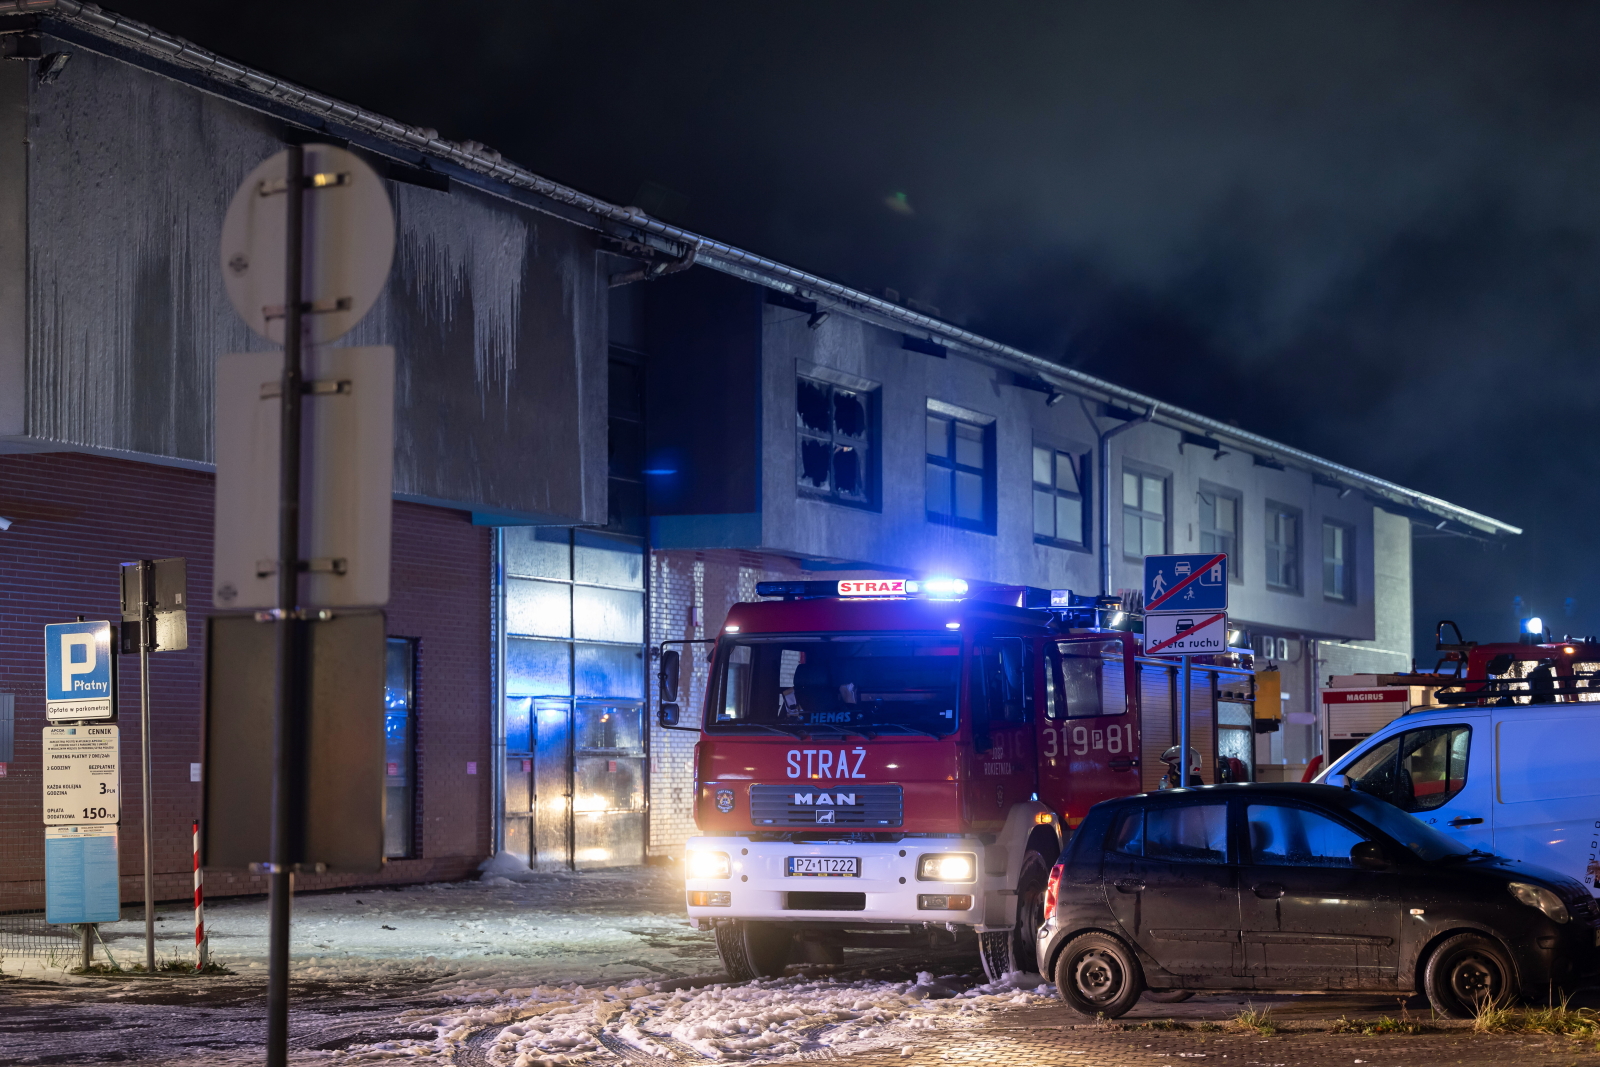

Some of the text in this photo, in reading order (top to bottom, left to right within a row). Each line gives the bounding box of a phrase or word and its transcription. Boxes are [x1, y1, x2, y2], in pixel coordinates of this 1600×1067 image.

[1189, 637, 1219, 648] ruchu
[61, 632, 97, 692] P
[74, 679, 108, 693] Płatny
[1346, 693, 1384, 702] MAGIRUS
[75, 704, 109, 713] parkometrze
[810, 711, 851, 723] HENAS
[786, 746, 867, 779] STRAŻ
[99, 782, 107, 795] 3
[794, 792, 856, 806] MAN
[82, 807, 107, 820] 150
[796, 859, 854, 872] PZ 1T222
